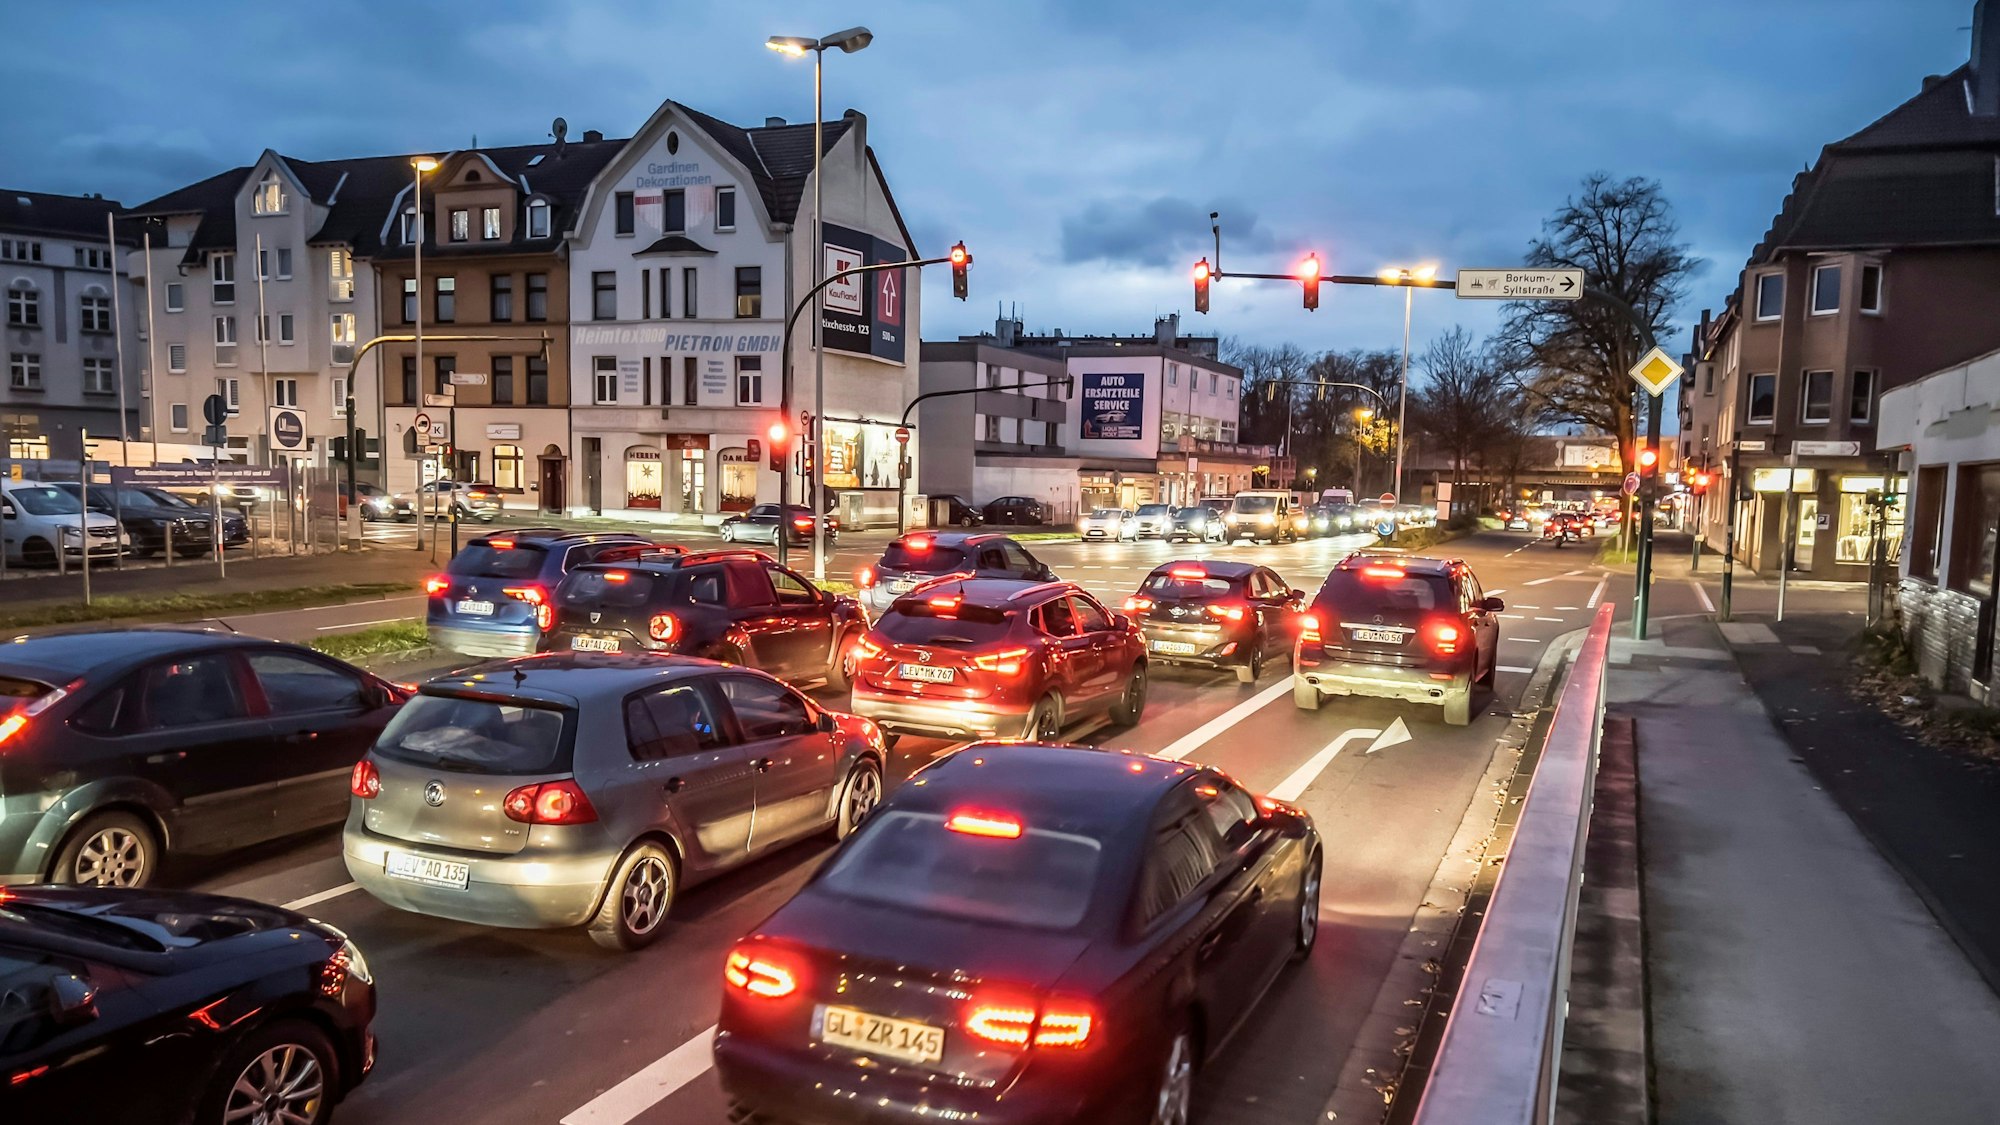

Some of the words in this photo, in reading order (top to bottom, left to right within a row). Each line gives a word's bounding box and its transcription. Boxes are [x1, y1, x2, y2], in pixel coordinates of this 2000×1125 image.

[648, 162, 698, 174] Gardinen
[637, 175, 711, 188] Dekorationen
[1506, 274, 1555, 282] Borkum-/
[829, 288, 857, 301] Kaufland
[1503, 285, 1554, 295] Syltstraße
[822, 318, 856, 333] tixchesstr.
[858, 324, 869, 335] 123
[665, 335, 734, 351] PIETRON
[737, 336, 780, 352] GMBH
[1101, 376, 1124, 386] AUTO
[1085, 388, 1140, 398] ERSATZTEILE
[1094, 400, 1129, 410] SERVICE
[576, 639, 590, 648] LEV
[603, 642, 616, 651] 226
[904, 666, 920, 676] LEV
[926, 668, 935, 678] MK
[938, 670, 952, 679] 767
[396, 857, 417, 873] LEV
[425, 862, 440, 876] AQ
[445, 865, 466, 881] 135
[826, 1012, 850, 1036] GL
[867, 1020, 893, 1046] ZR
[897, 1028, 940, 1054] 145
